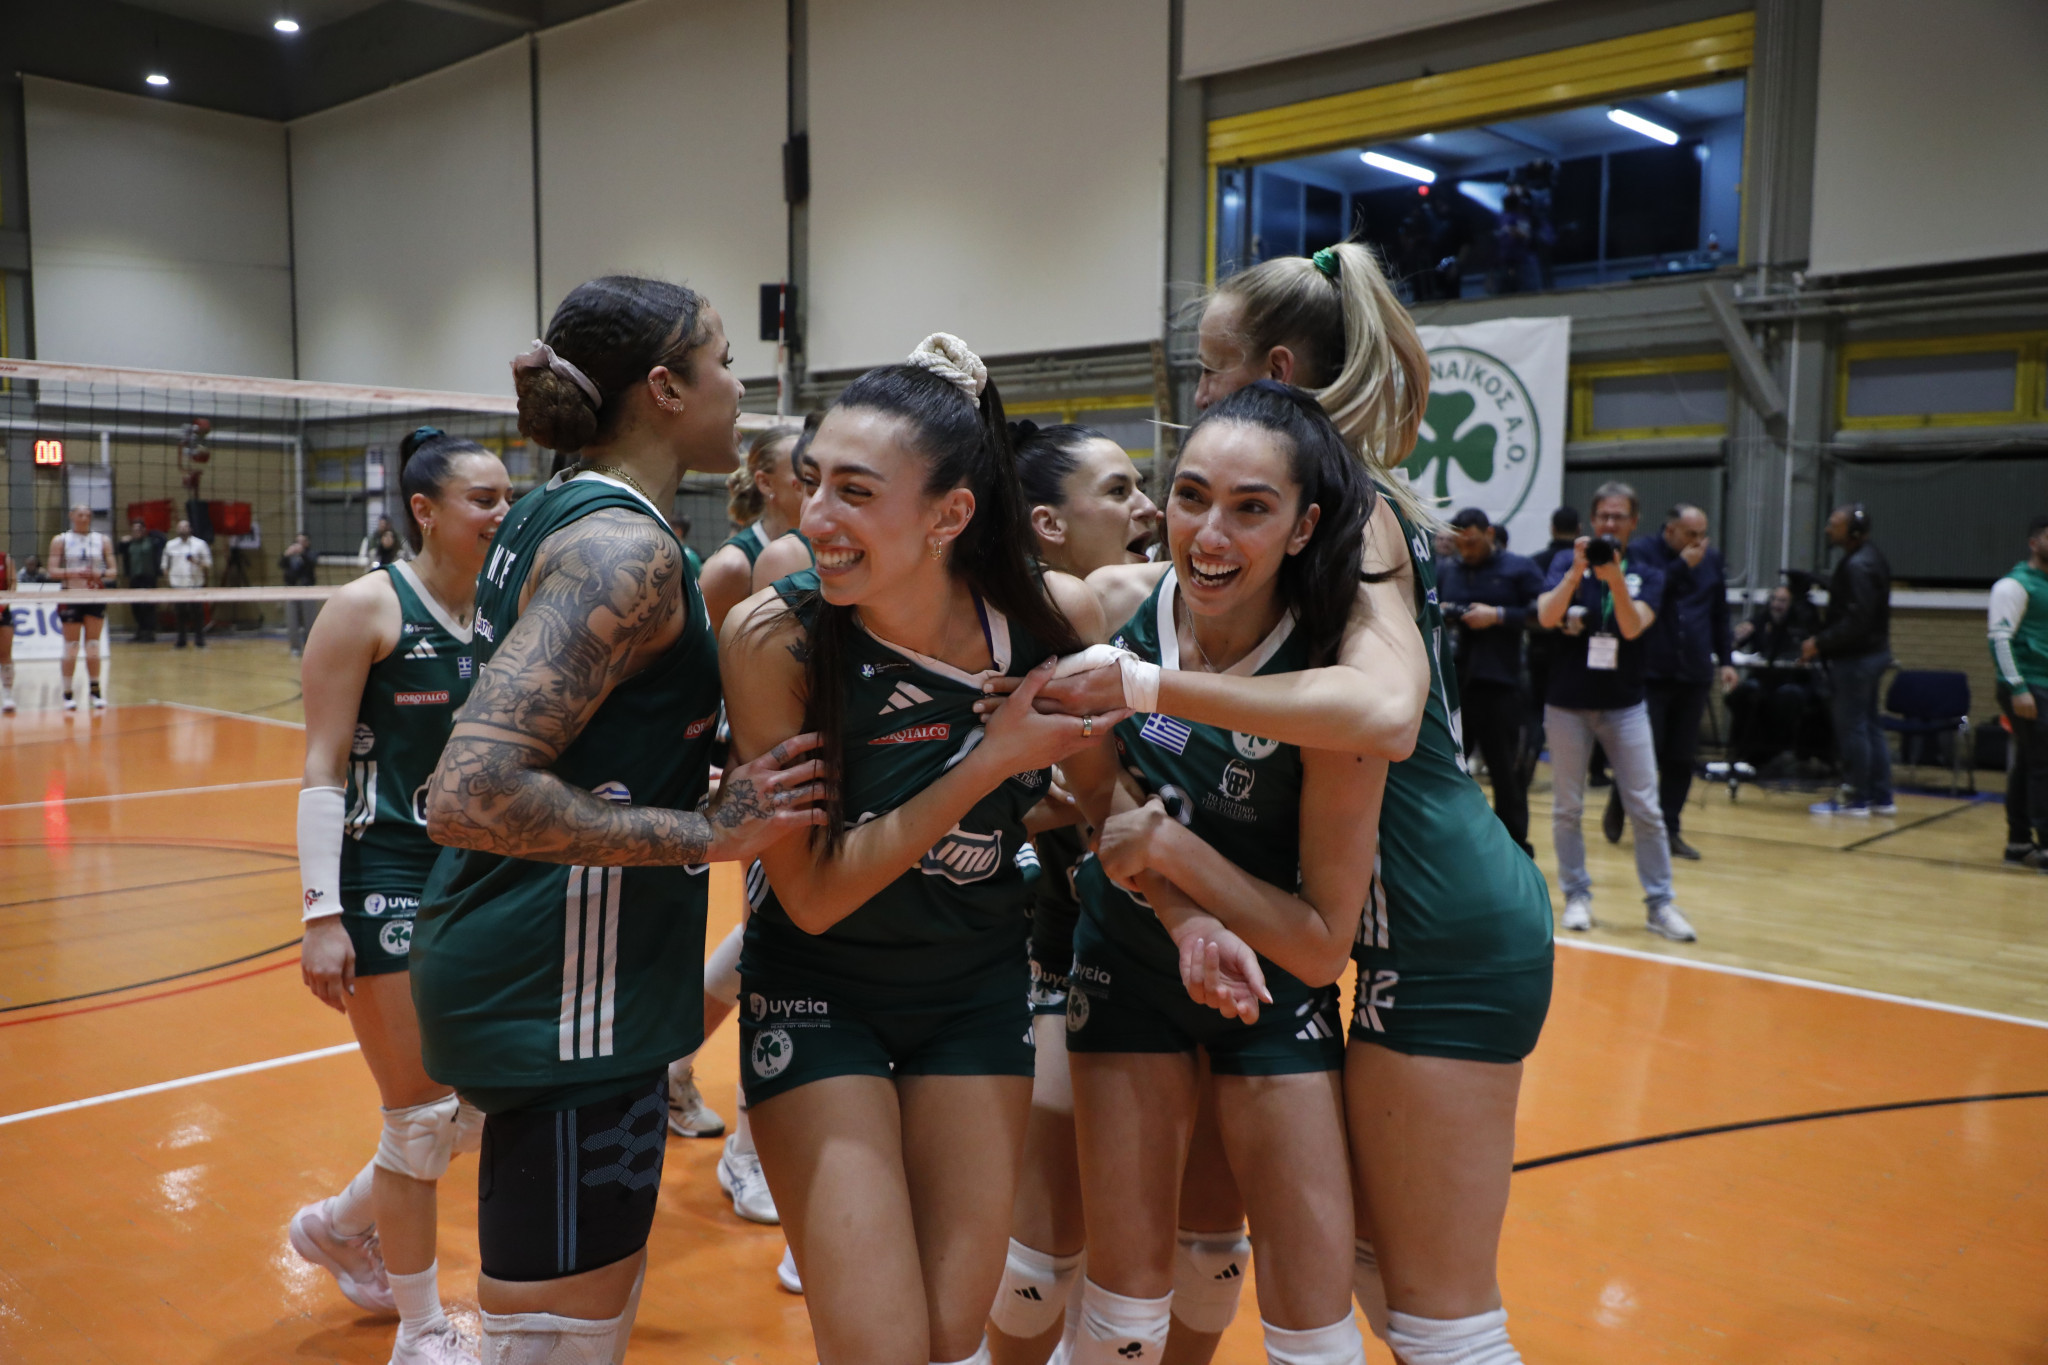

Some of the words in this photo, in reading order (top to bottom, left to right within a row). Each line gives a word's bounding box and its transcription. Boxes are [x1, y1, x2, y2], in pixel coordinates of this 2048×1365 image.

[34, 440, 62, 465] 00
[396, 693, 448, 704] BOROTALCO
[764, 1067, 780, 1076] 1908
